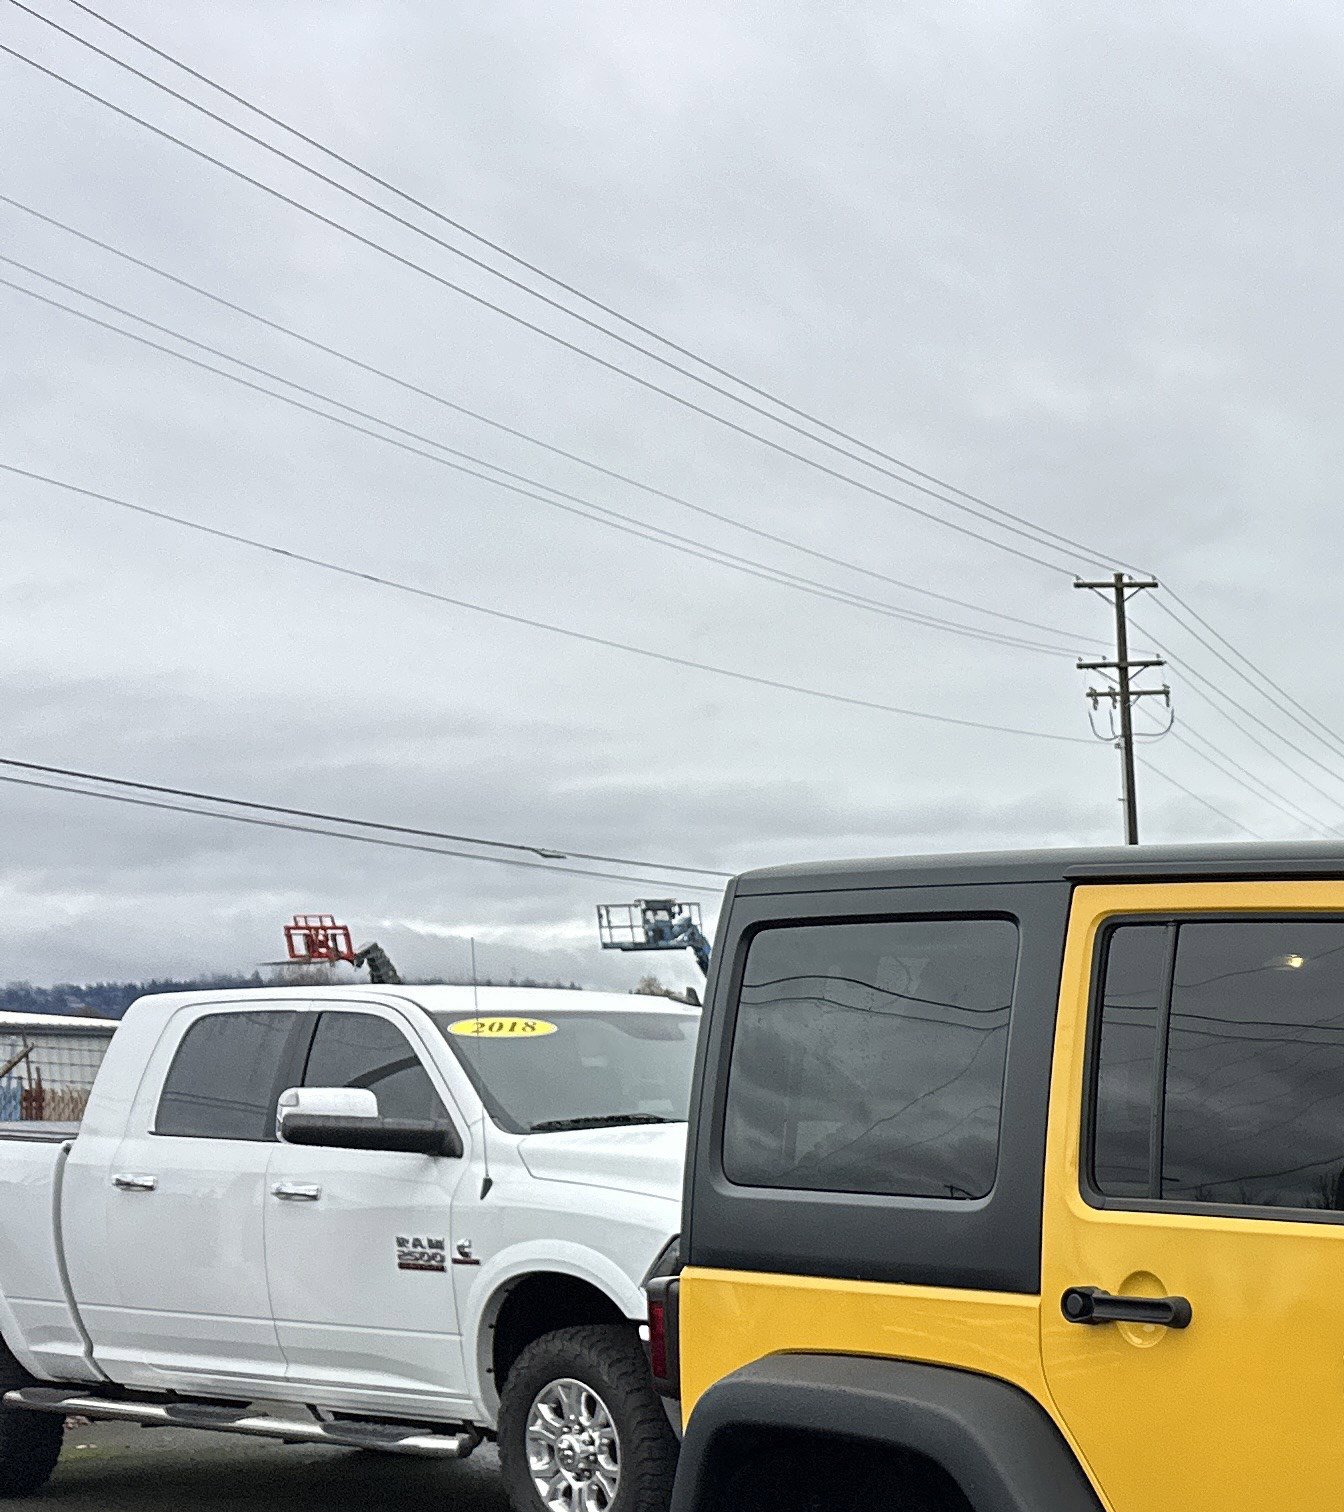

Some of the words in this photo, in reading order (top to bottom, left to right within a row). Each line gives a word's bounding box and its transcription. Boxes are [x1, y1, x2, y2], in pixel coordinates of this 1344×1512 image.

[471, 1021, 537, 1034] 2018
[396, 1236, 445, 1250] RAM
[397, 1249, 446, 1263] 2500
